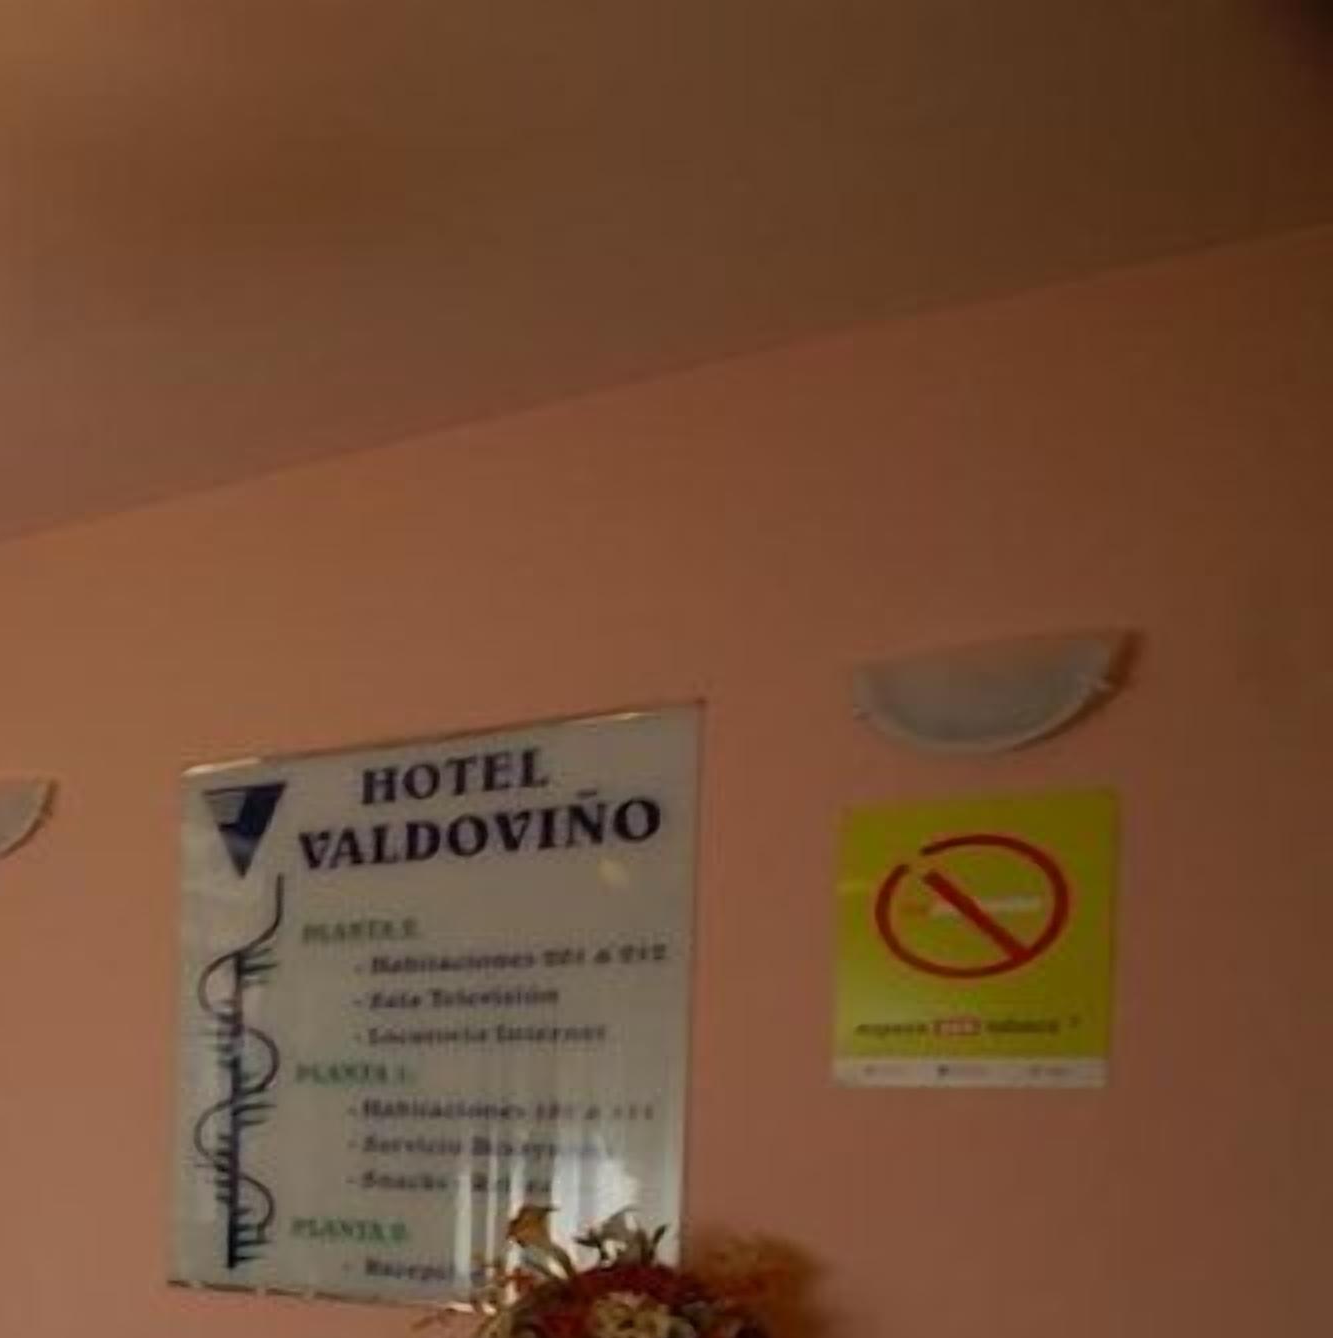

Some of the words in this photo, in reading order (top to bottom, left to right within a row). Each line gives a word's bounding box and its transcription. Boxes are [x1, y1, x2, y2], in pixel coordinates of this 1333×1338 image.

[360, 746, 550, 805] HOTEL
[298, 789, 662, 870] VALDOVIÑO
[294, 1064, 389, 1086] PLANTA
[292, 1217, 384, 1245] PLANTA
